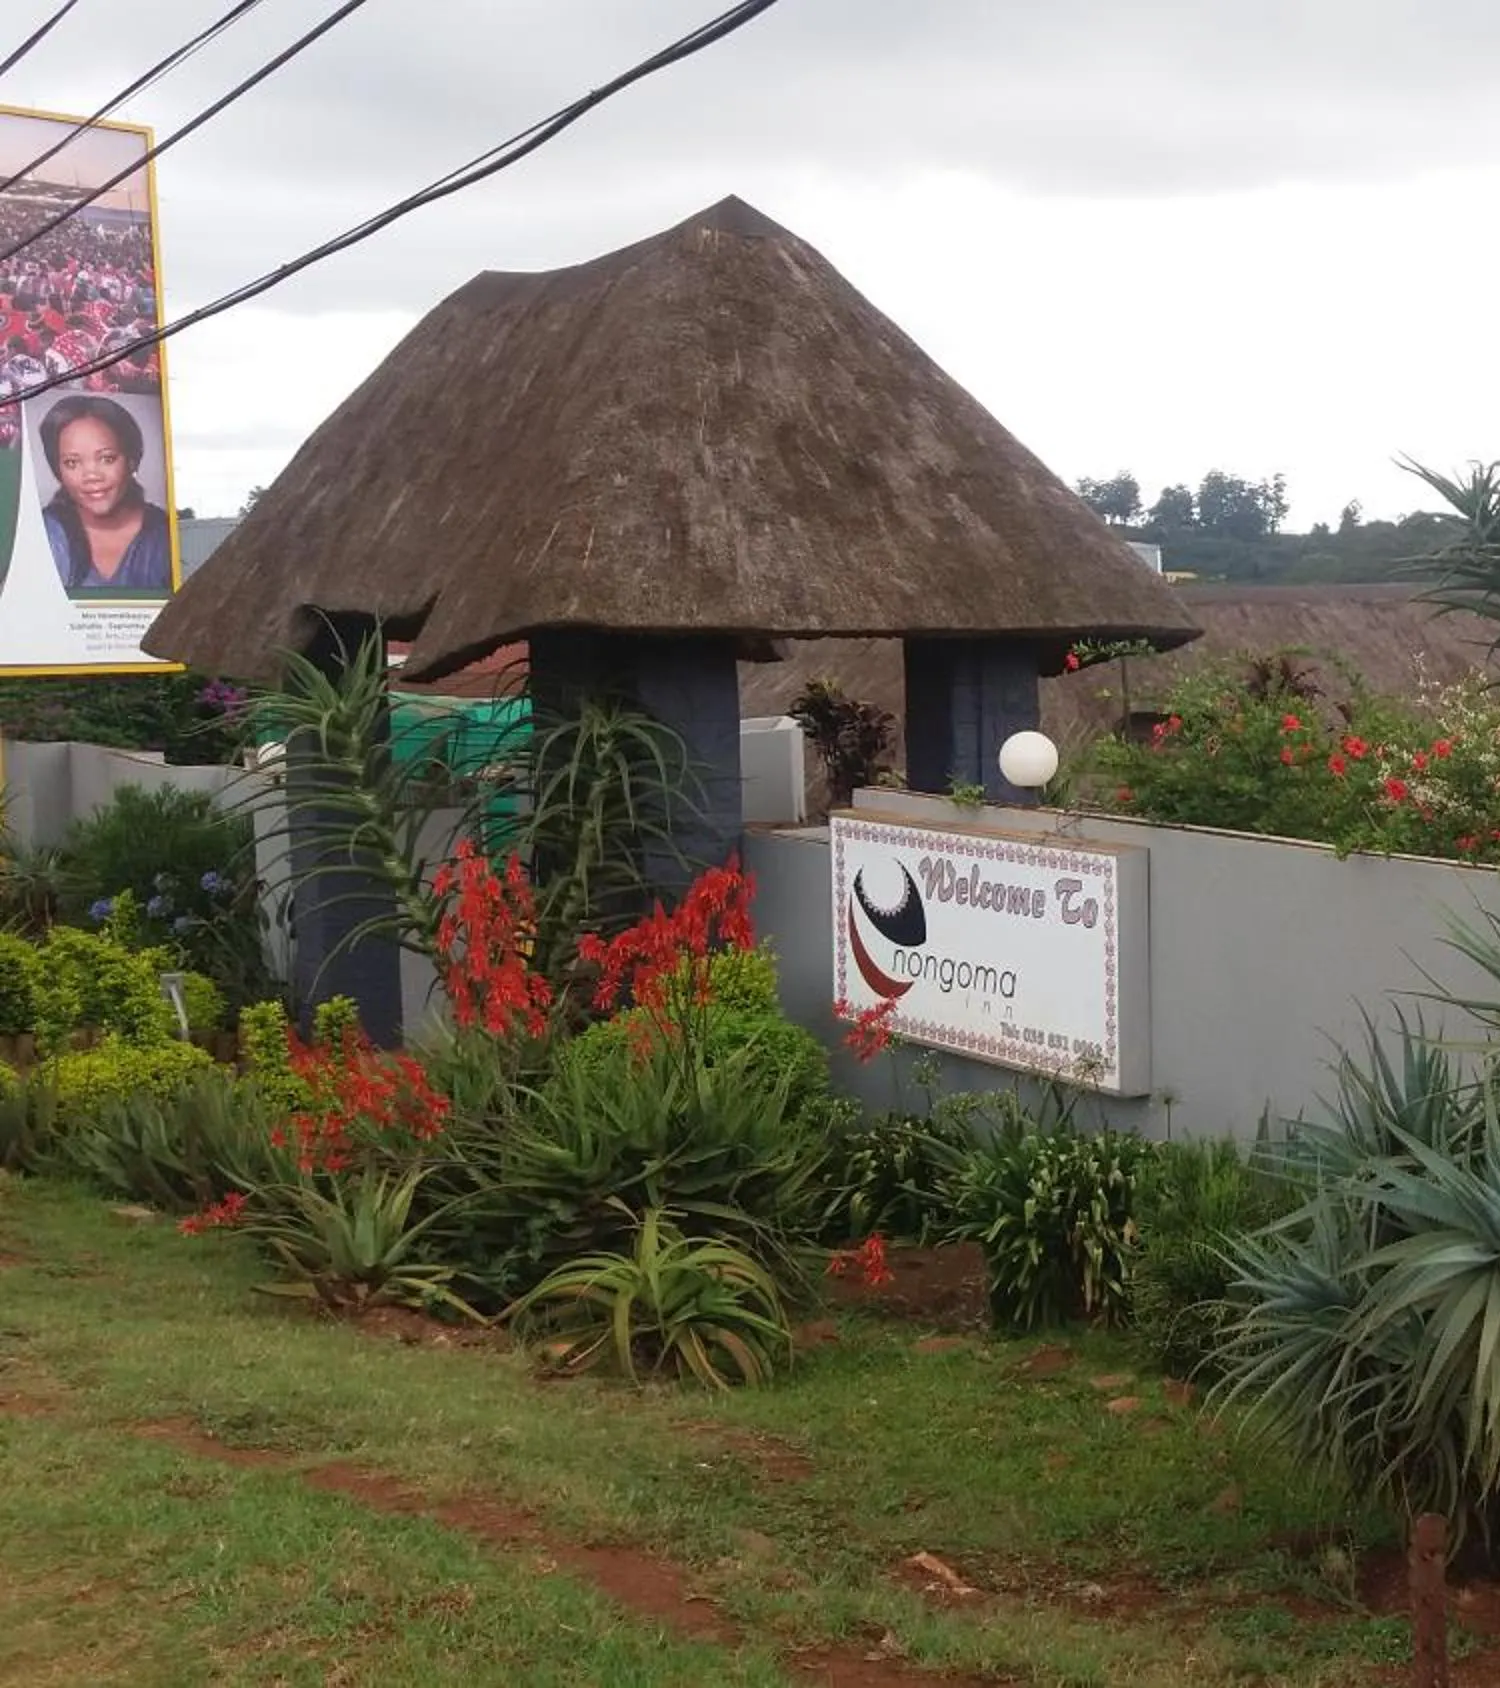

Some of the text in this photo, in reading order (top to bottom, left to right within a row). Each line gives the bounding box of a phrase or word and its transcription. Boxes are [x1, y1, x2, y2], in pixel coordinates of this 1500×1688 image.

[918, 856, 1099, 928] Welcome To
[891, 949, 1018, 999] nongoma
